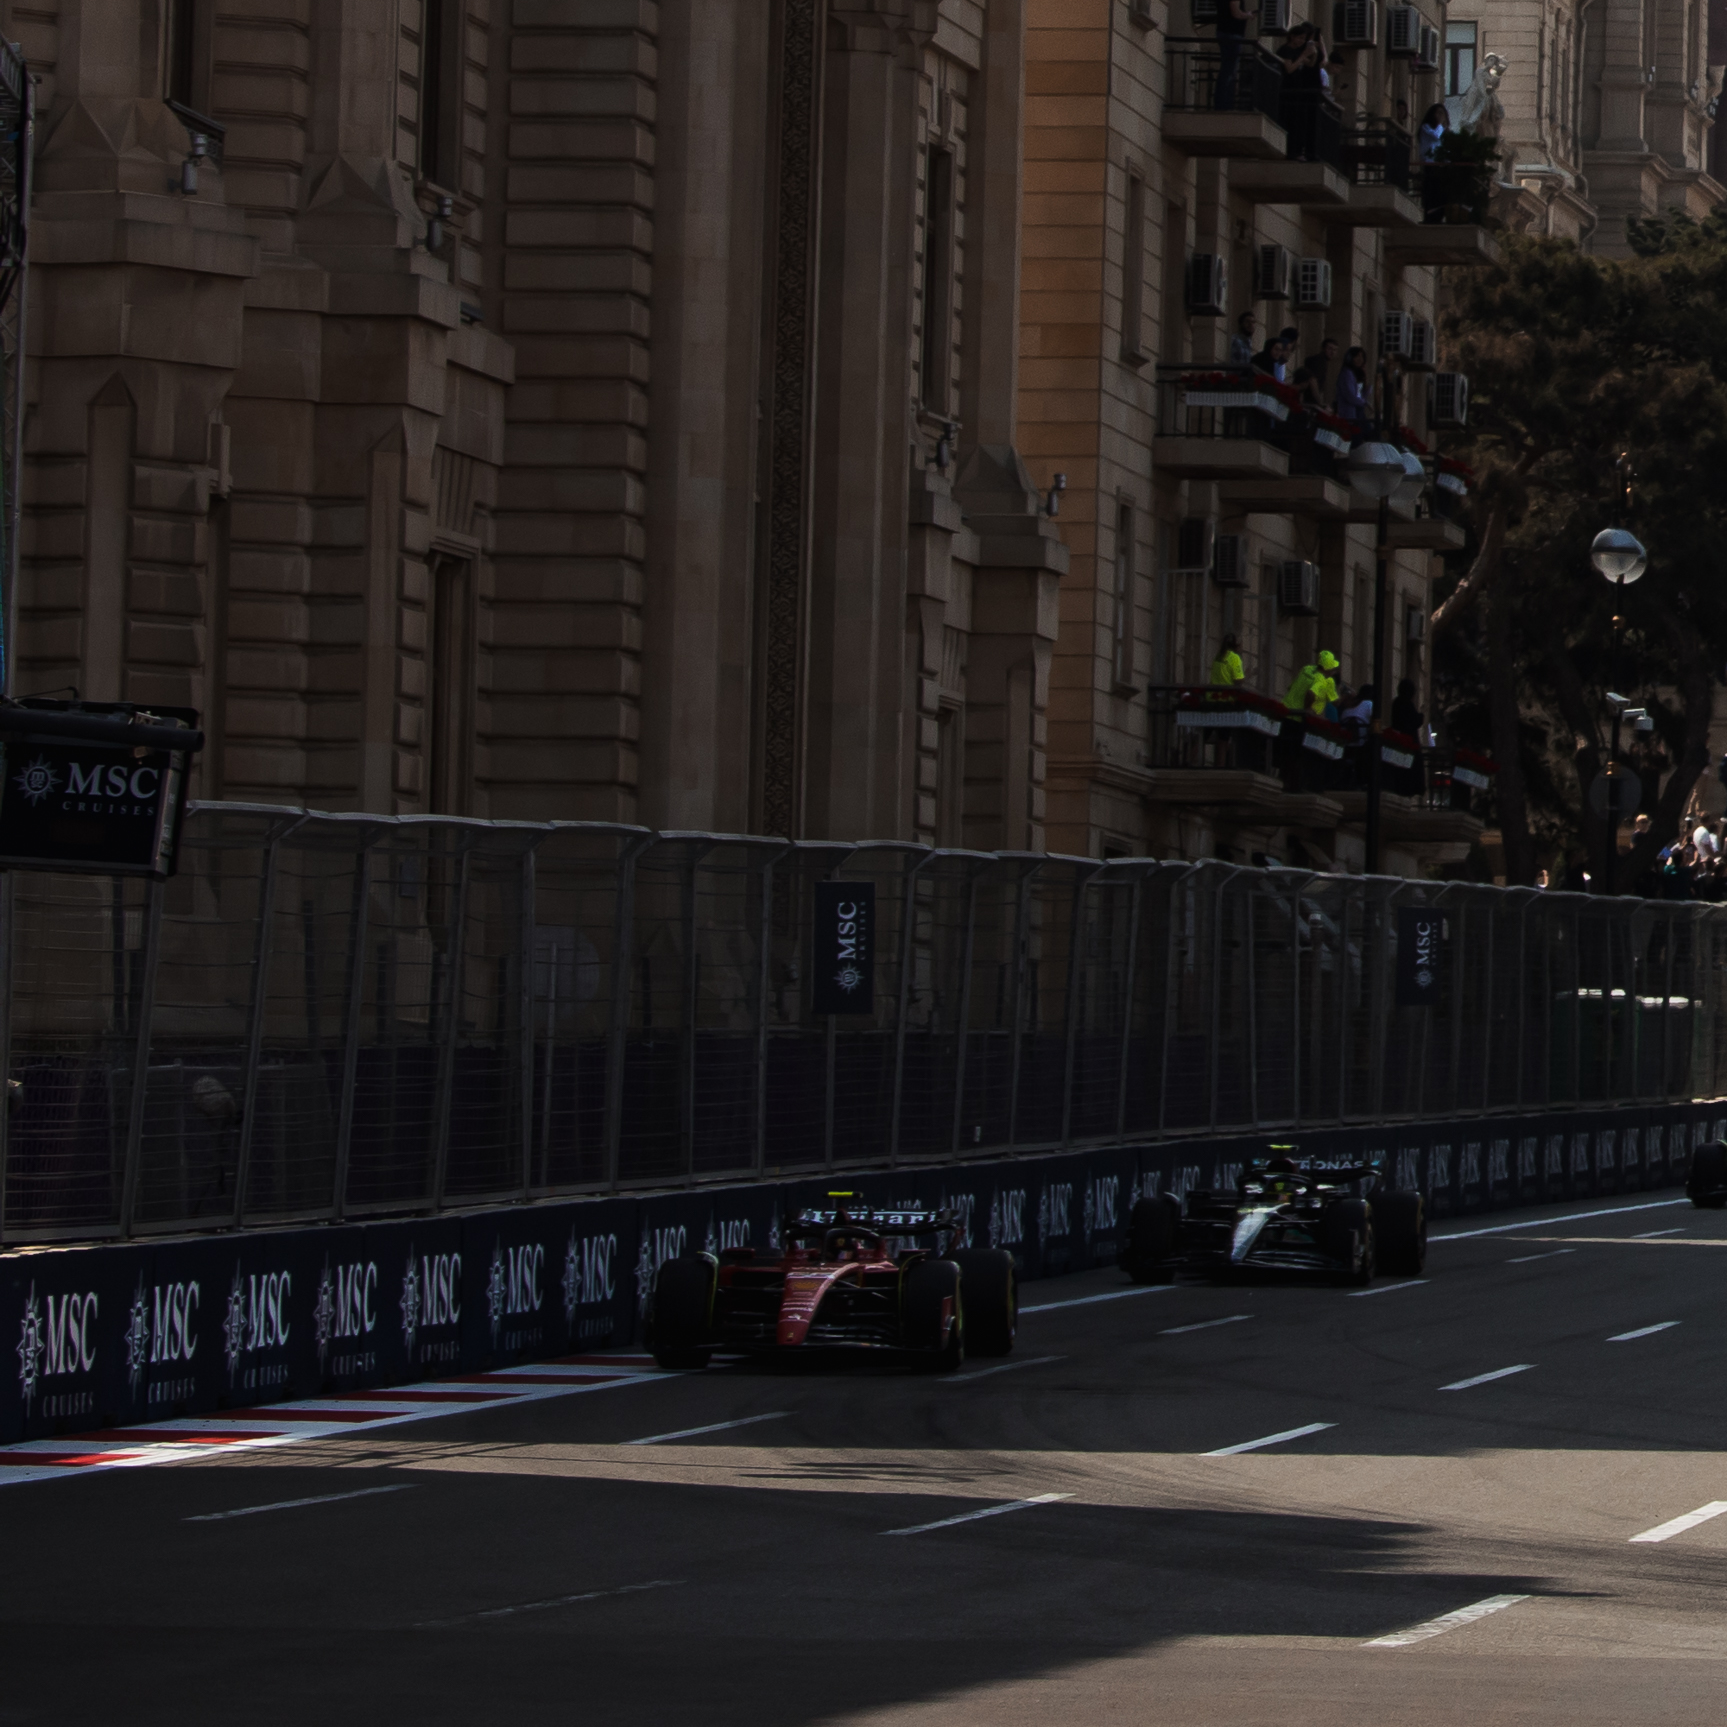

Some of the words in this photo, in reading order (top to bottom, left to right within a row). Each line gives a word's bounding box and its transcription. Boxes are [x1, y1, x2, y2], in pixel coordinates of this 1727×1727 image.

[62, 800, 154, 817] CRUISES
[64, 762, 159, 799] MSC
[837, 901, 857, 961] MSC
[1416, 922, 1431, 966] MSC
[334, 1261, 378, 1338] MSC
[421, 1252, 462, 1326] MSC
[506, 1243, 545, 1314] MSC
[581, 1233, 617, 1304] MSC
[44, 1291, 98, 1375] MSC
[150, 1280, 200, 1364] MSC
[246, 1270, 292, 1351] MSC
[42, 1391, 94, 1419] CRUISES
